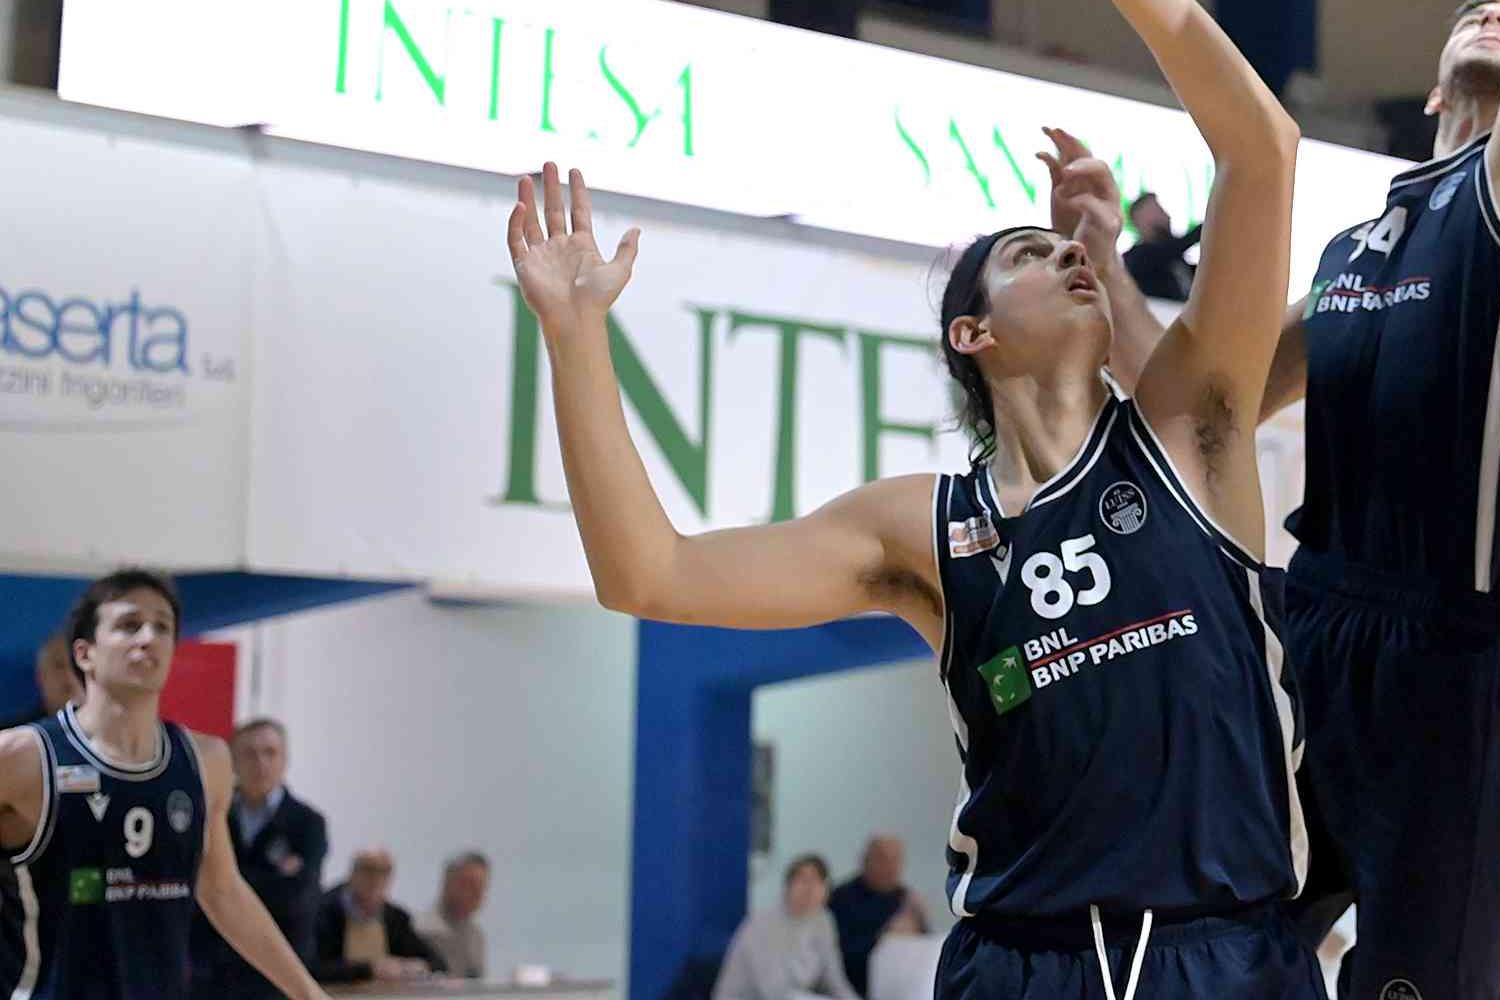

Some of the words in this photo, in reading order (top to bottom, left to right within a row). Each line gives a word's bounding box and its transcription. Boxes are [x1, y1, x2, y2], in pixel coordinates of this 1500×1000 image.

[0, 283, 190, 376] serta
[1021, 534, 1111, 619] 85
[1024, 628, 1078, 662] BNL
[1032, 652, 1086, 689] BNP
[1089, 615, 1198, 665] PARIBAS
[124, 806, 154, 857] 9
